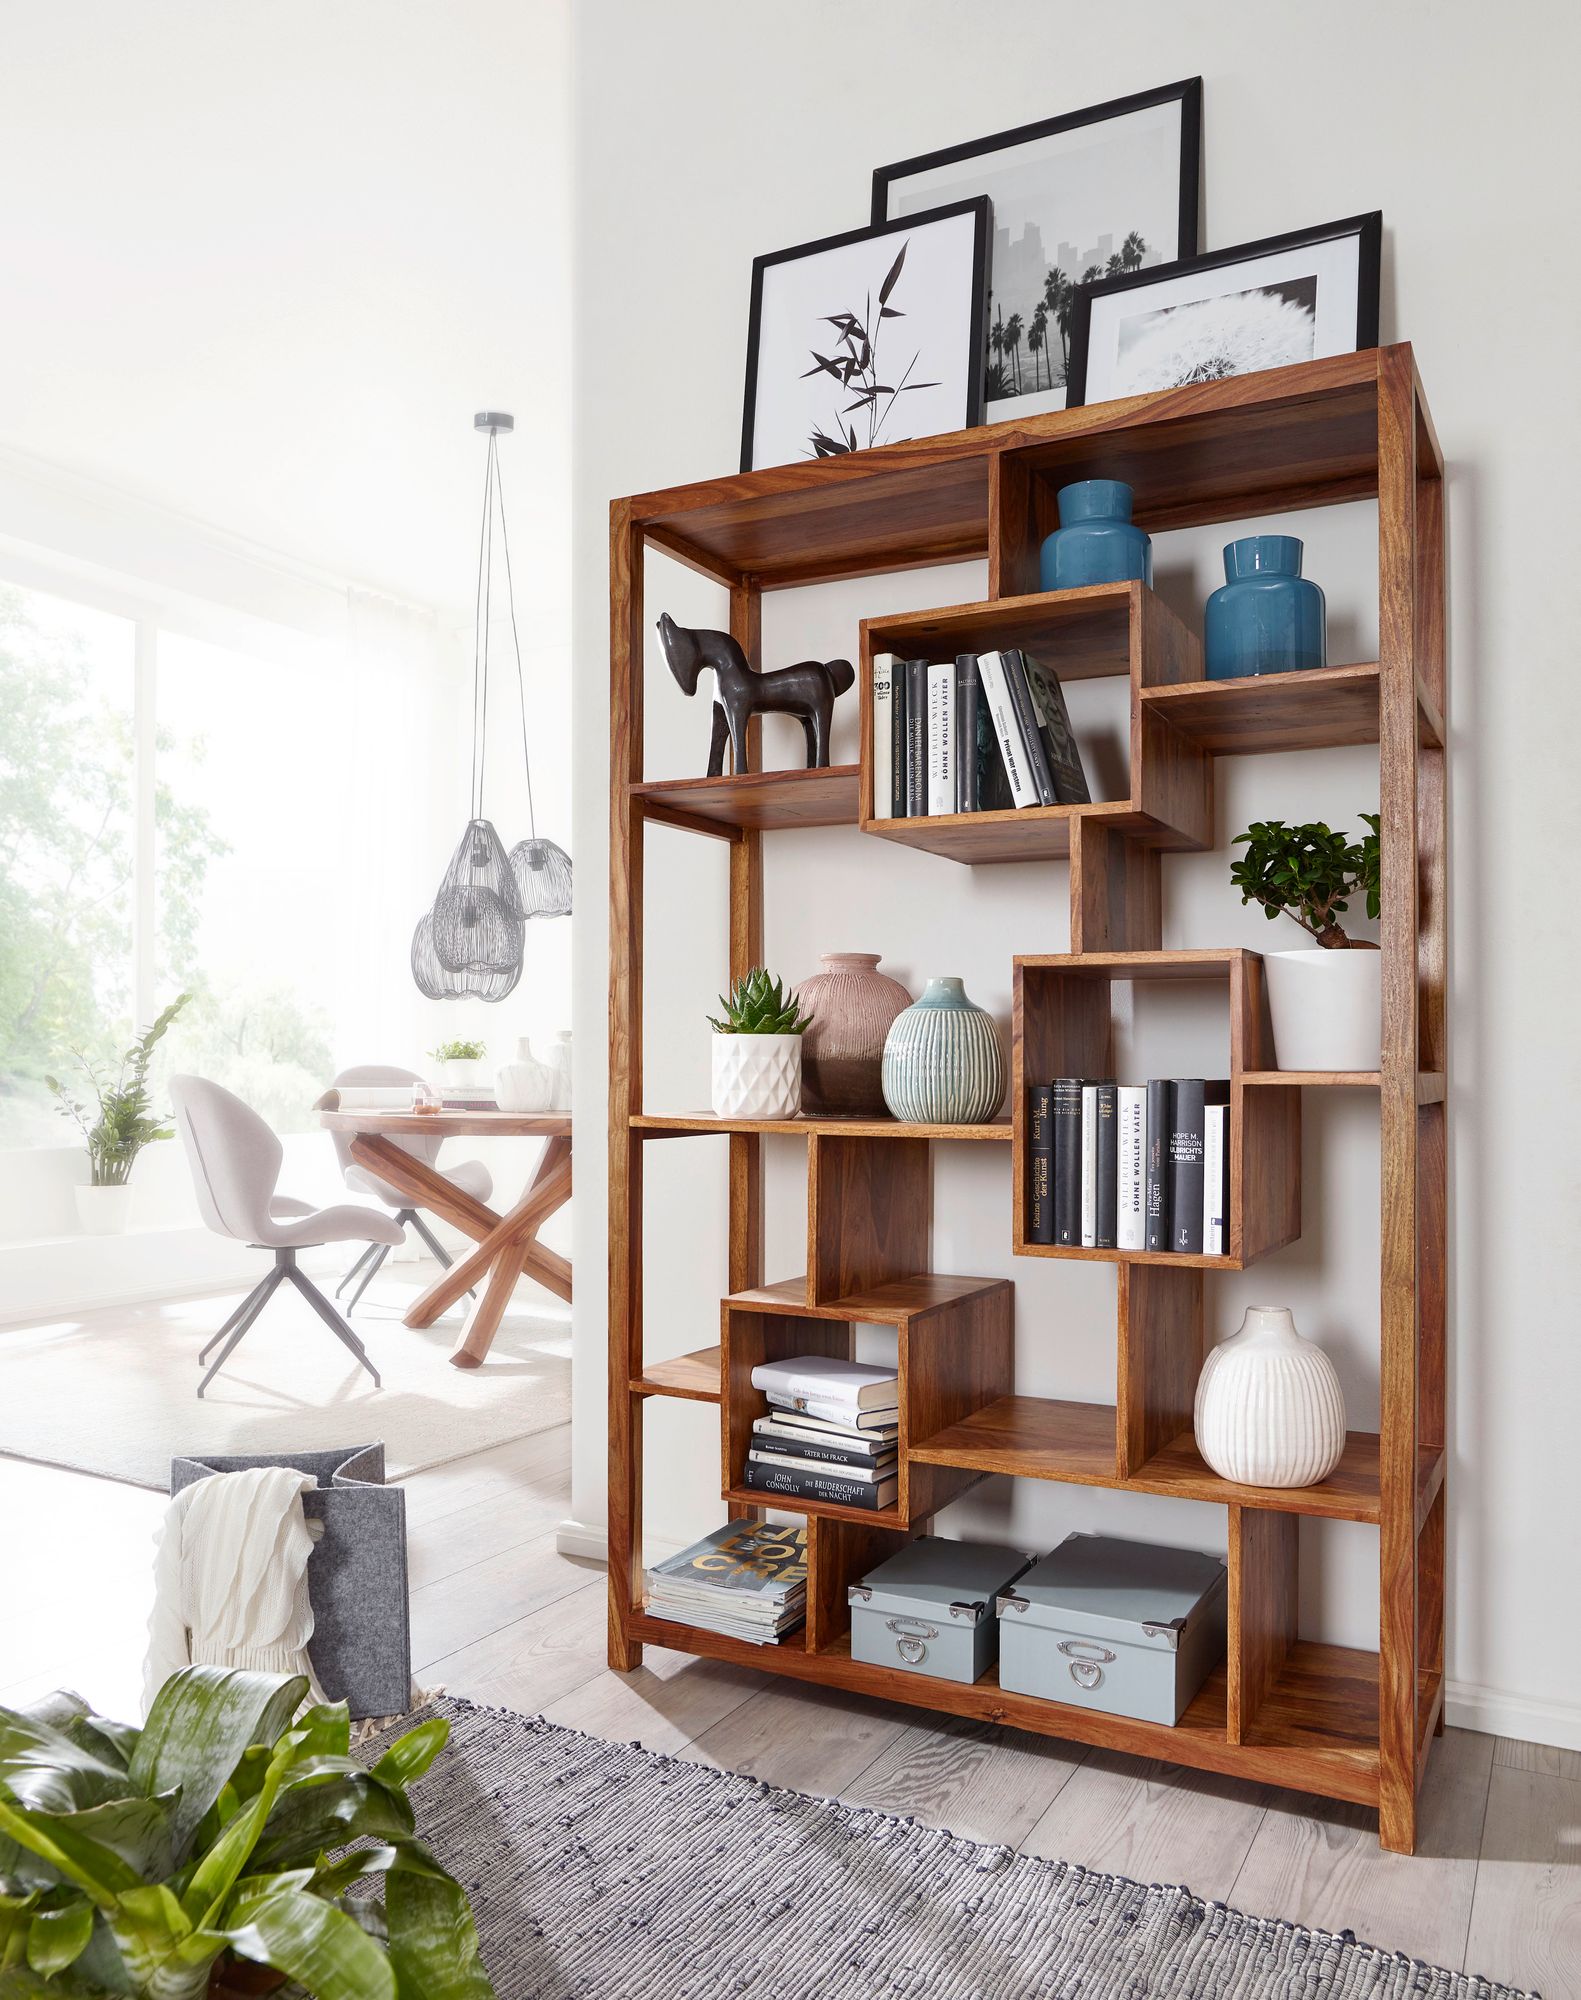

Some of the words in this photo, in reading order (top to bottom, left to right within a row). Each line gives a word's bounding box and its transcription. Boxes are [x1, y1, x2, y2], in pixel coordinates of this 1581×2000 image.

[914, 718, 922, 748] DANIEL
[1003, 739, 1012, 757] Privat
[1010, 769, 1021, 793] gestern
[914, 750, 922, 801] BARENBOIM
[1040, 1097, 1049, 1118] Jung
[1033, 1120, 1041, 1140] Kurt
[1190, 1132, 1199, 1140] M.
[1170, 1139, 1202, 1147] HARRISON
[1149, 1184, 1162, 1217] Hagen
[804, 1449, 821, 1458] TÄTER
[830, 1453, 849, 1463] FRACK
[774, 1472, 792, 1483] JOHN
[766, 1480, 800, 1493] CONNOLLY
[804, 1480, 813, 1488] DIE
[814, 1480, 865, 1496] BRUDERSCHAFT
[818, 1490, 828, 1498] DER
[828, 1490, 852, 1501] NACHT
